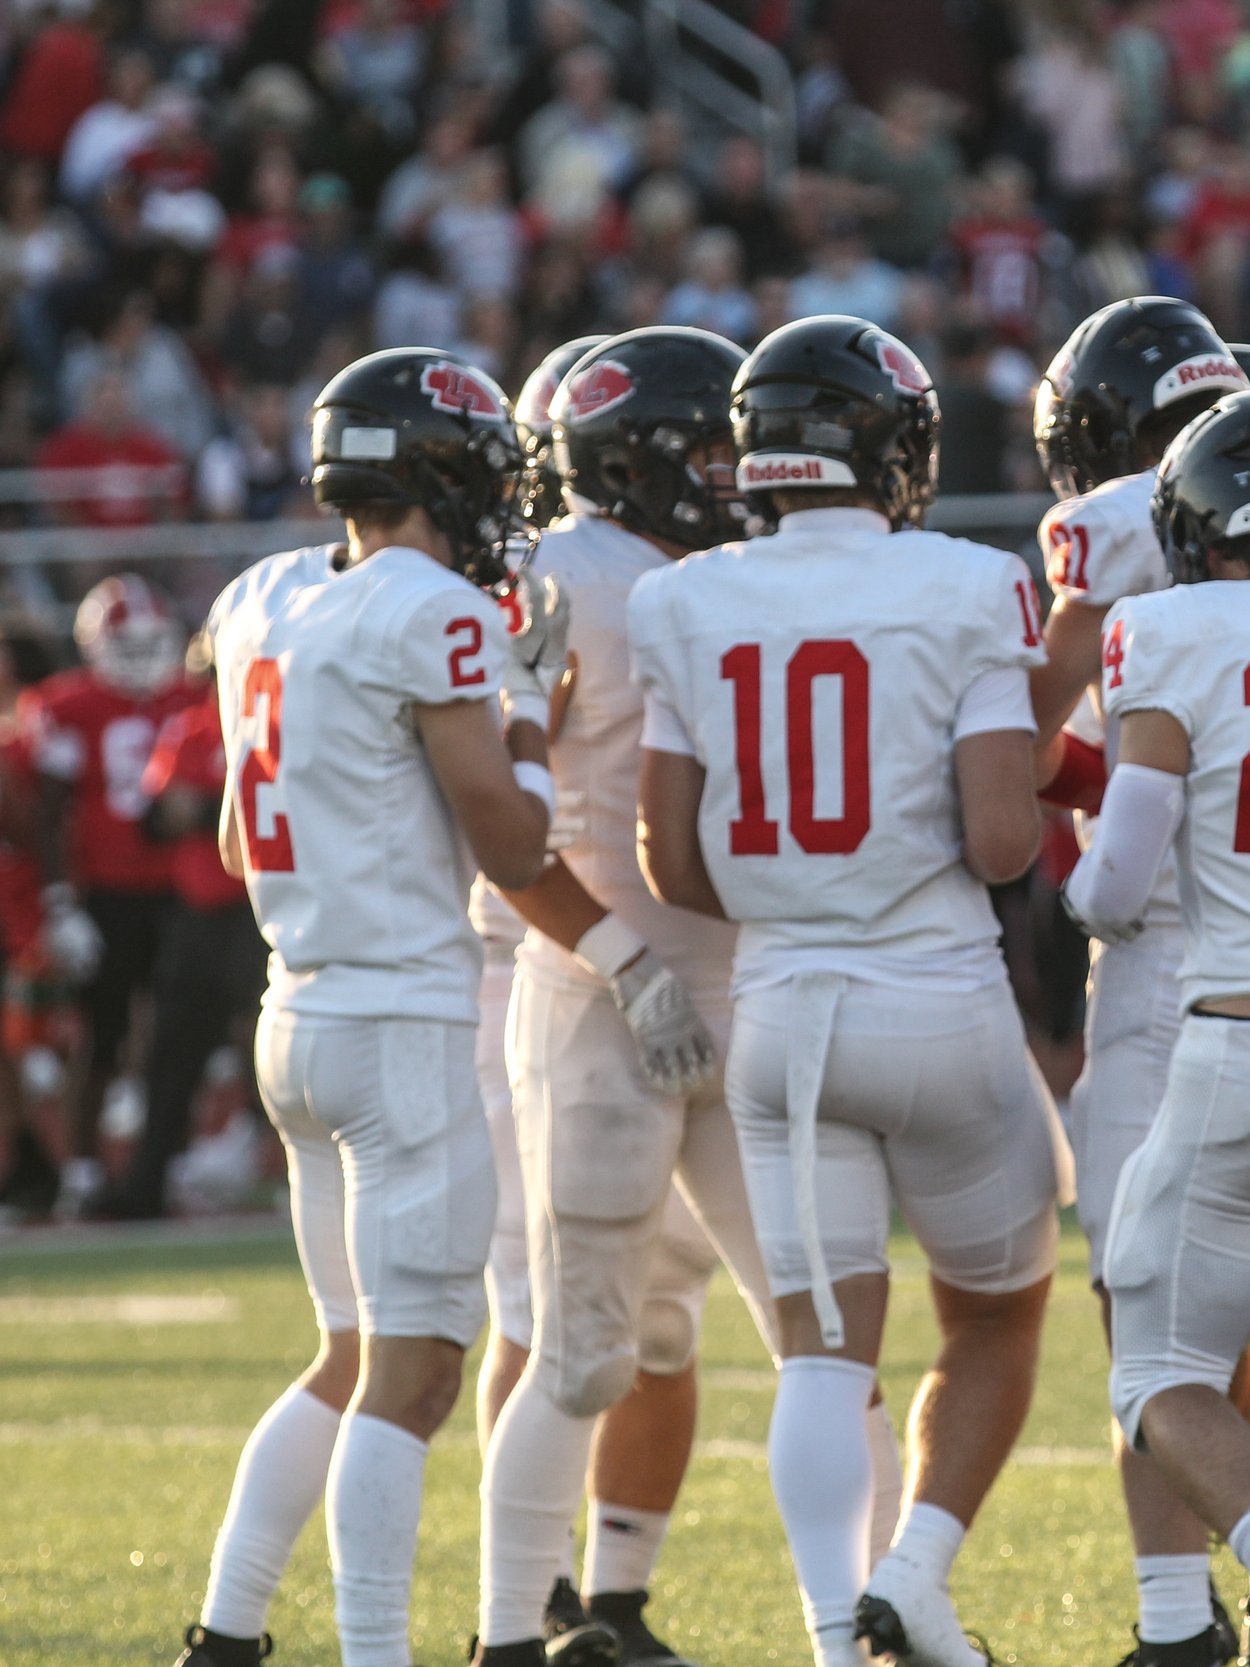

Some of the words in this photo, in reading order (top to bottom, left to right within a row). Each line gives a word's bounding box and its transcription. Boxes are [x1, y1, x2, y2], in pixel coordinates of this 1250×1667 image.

[445, 616, 486, 687] 2
[1101, 619, 1125, 689] 4
[240, 657, 296, 872] 2
[721, 639, 871, 855] 10
